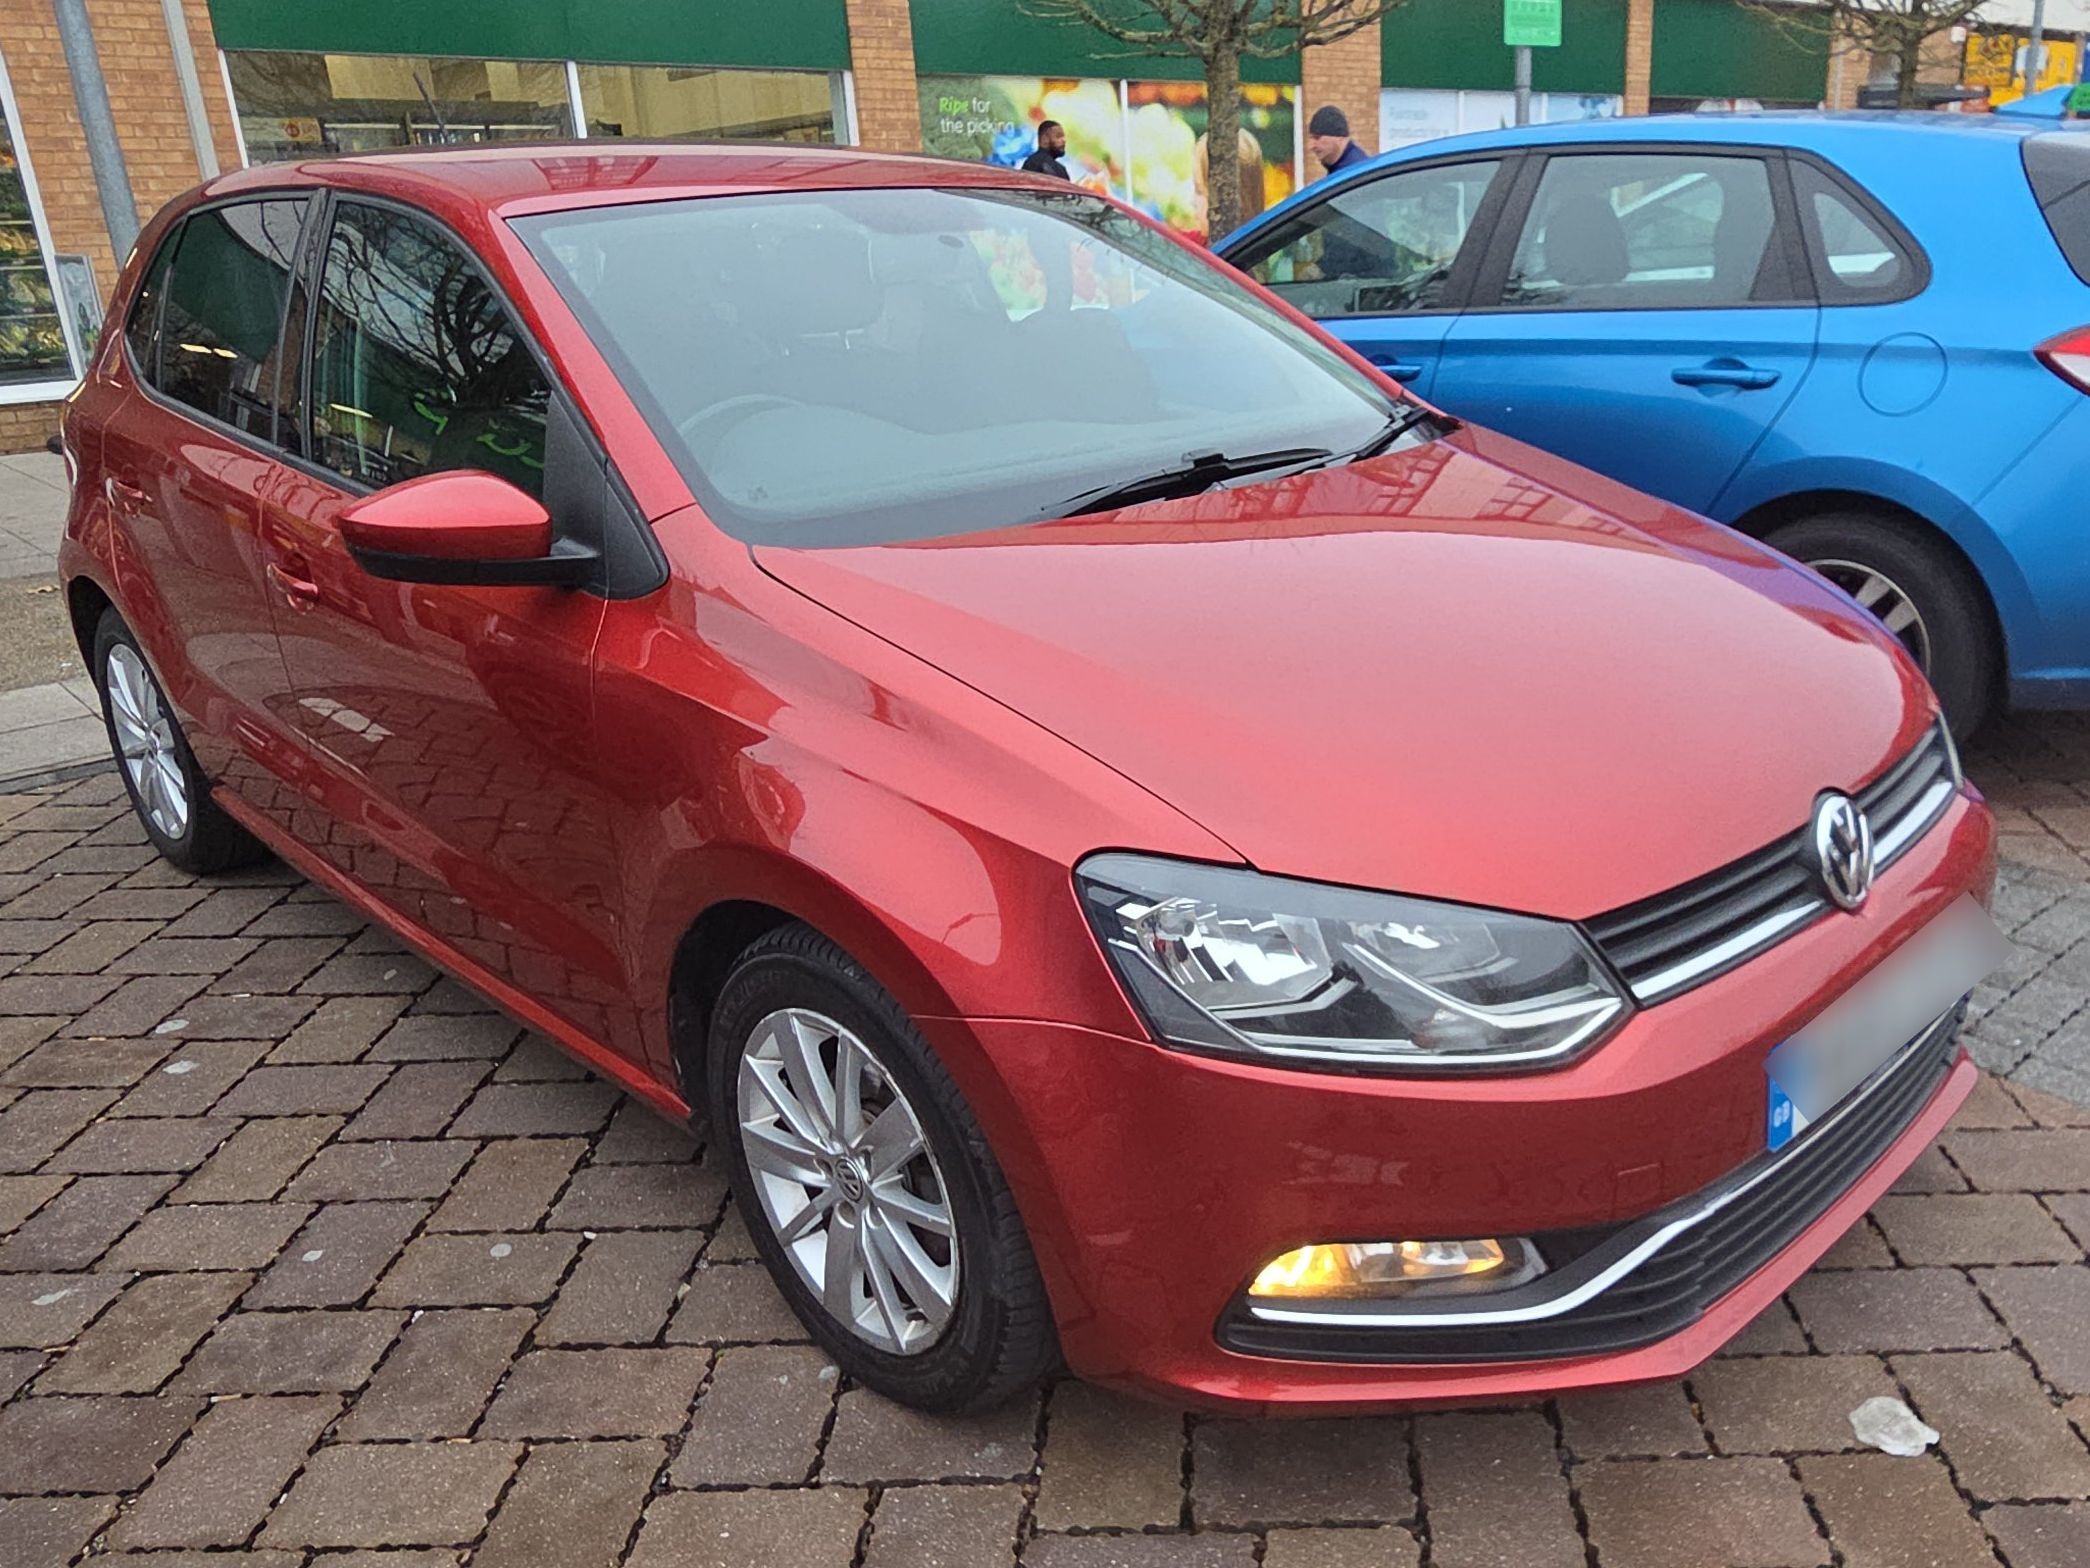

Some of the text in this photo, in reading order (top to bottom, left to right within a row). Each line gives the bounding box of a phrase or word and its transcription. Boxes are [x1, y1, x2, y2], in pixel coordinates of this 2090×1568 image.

[939, 96, 991, 116] Ripe for
[940, 117, 964, 133] the
